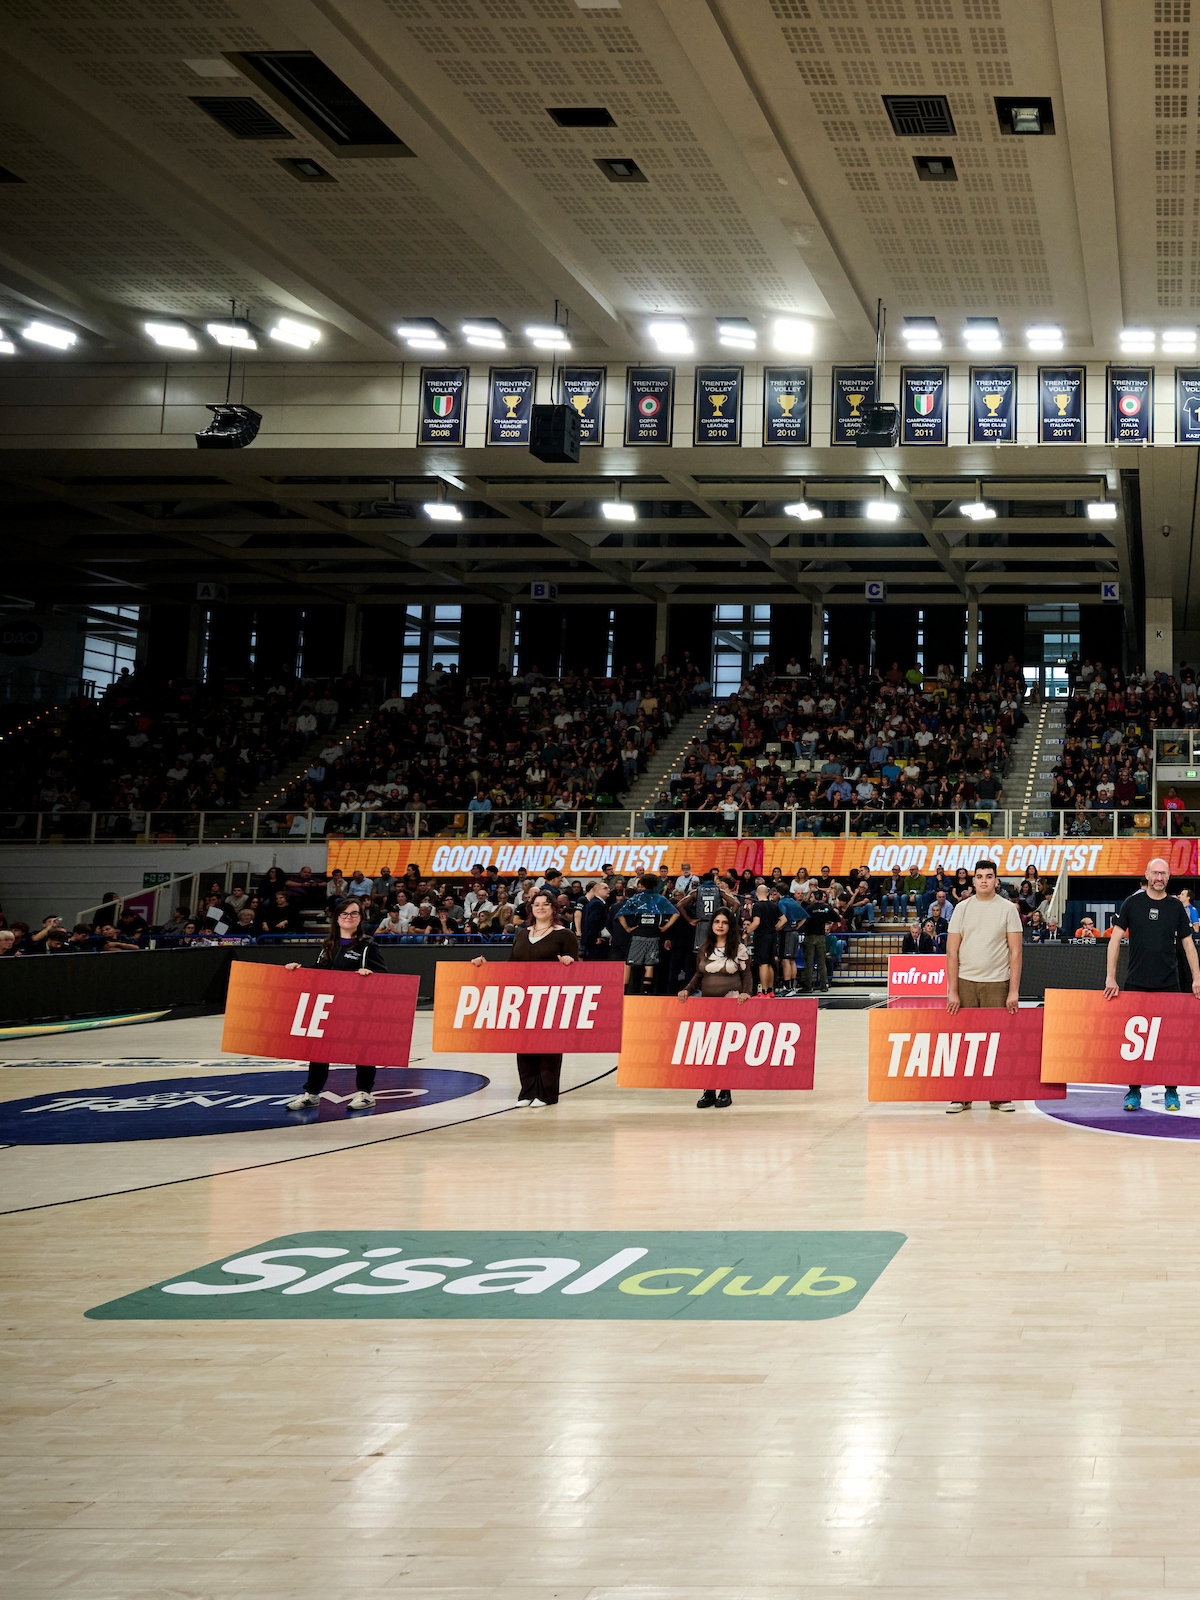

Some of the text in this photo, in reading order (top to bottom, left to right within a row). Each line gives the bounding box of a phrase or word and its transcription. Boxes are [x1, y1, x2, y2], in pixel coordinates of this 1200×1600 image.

[534, 584, 545, 596] B
[868, 583, 881, 597] C
[1103, 583, 1116, 597] K
[432, 845, 669, 872] GOOD HANDS CONTEST
[867, 844, 1103, 872] GOOD HANDS CONTEST
[704, 901, 713, 913] 21
[290, 992, 335, 1038] LE
[453, 985, 602, 1029] PARTITE
[671, 1020, 800, 1066] IMPOR
[888, 1032, 1000, 1077] TANTI
[1120, 1015, 1161, 1061] SI
[161, 1246, 857, 1296] Sisal Club
